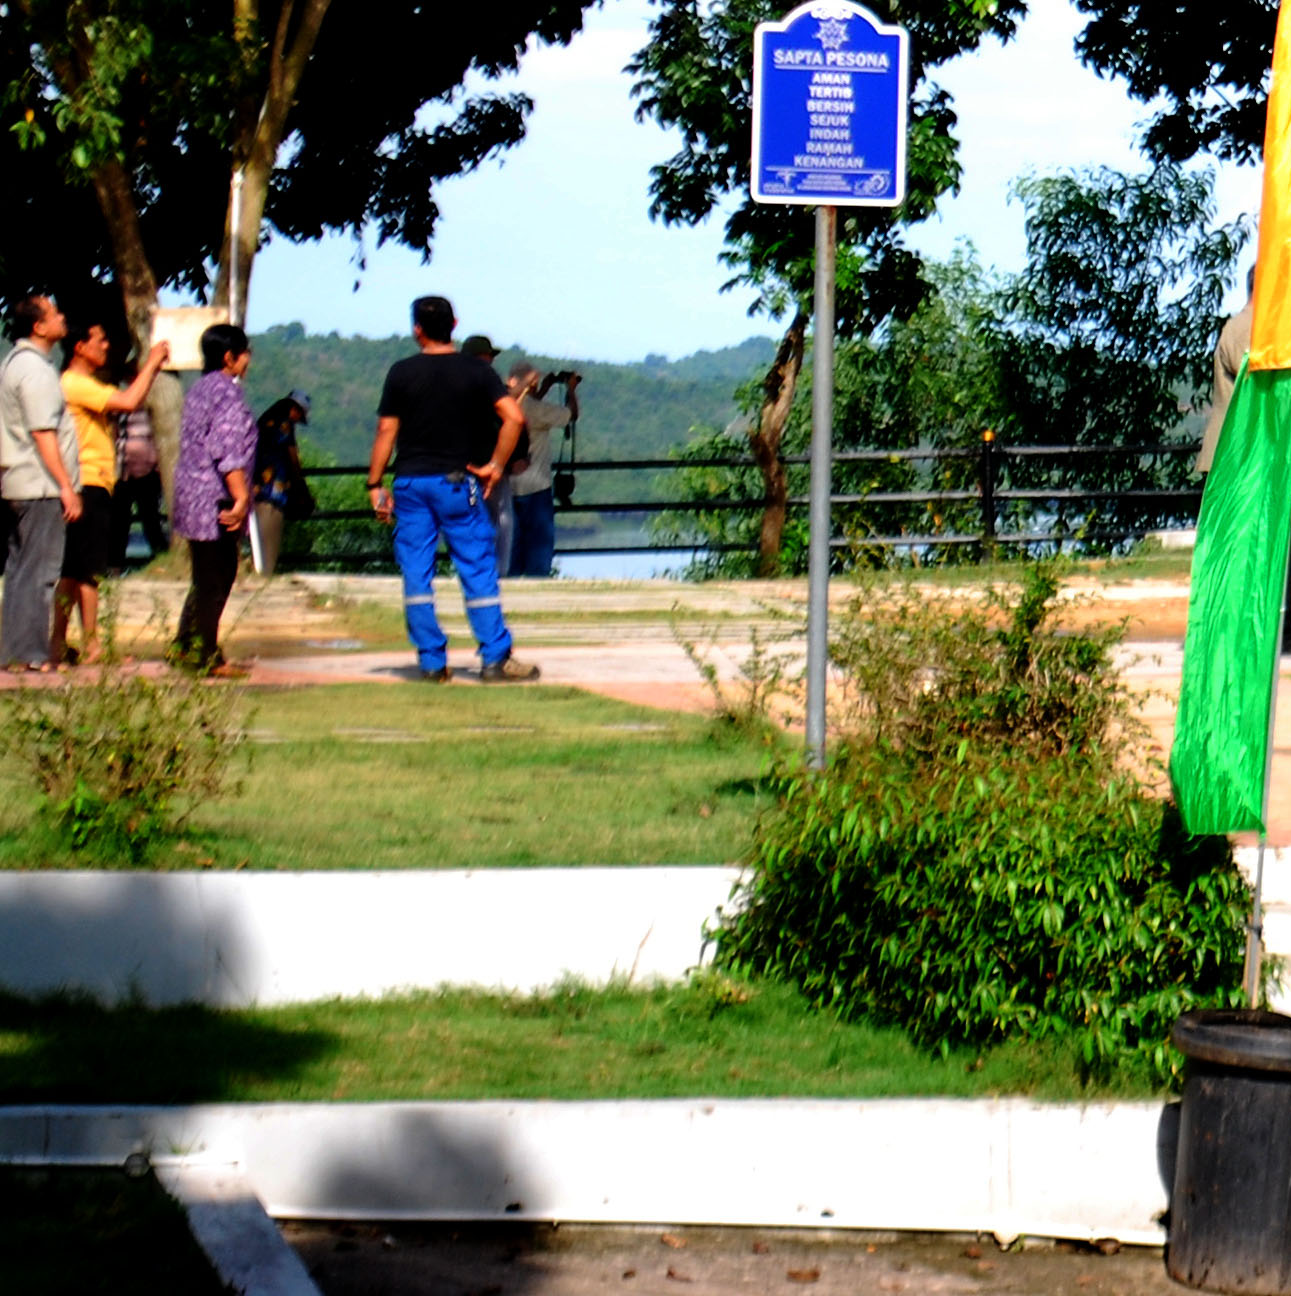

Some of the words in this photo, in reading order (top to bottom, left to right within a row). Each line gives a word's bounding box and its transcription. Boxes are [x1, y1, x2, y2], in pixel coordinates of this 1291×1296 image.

[773, 49, 823, 65] SAPTA
[825, 51, 890, 68] PESONA
[812, 73, 851, 85] AMAN
[808, 85, 853, 99] TERTIB
[806, 100, 855, 113] BERSIH
[809, 114, 850, 126] SEJUK
[809, 128, 850, 140] INDAH
[806, 142, 852, 154] RAMAH
[794, 155, 864, 168] KENANGAN
